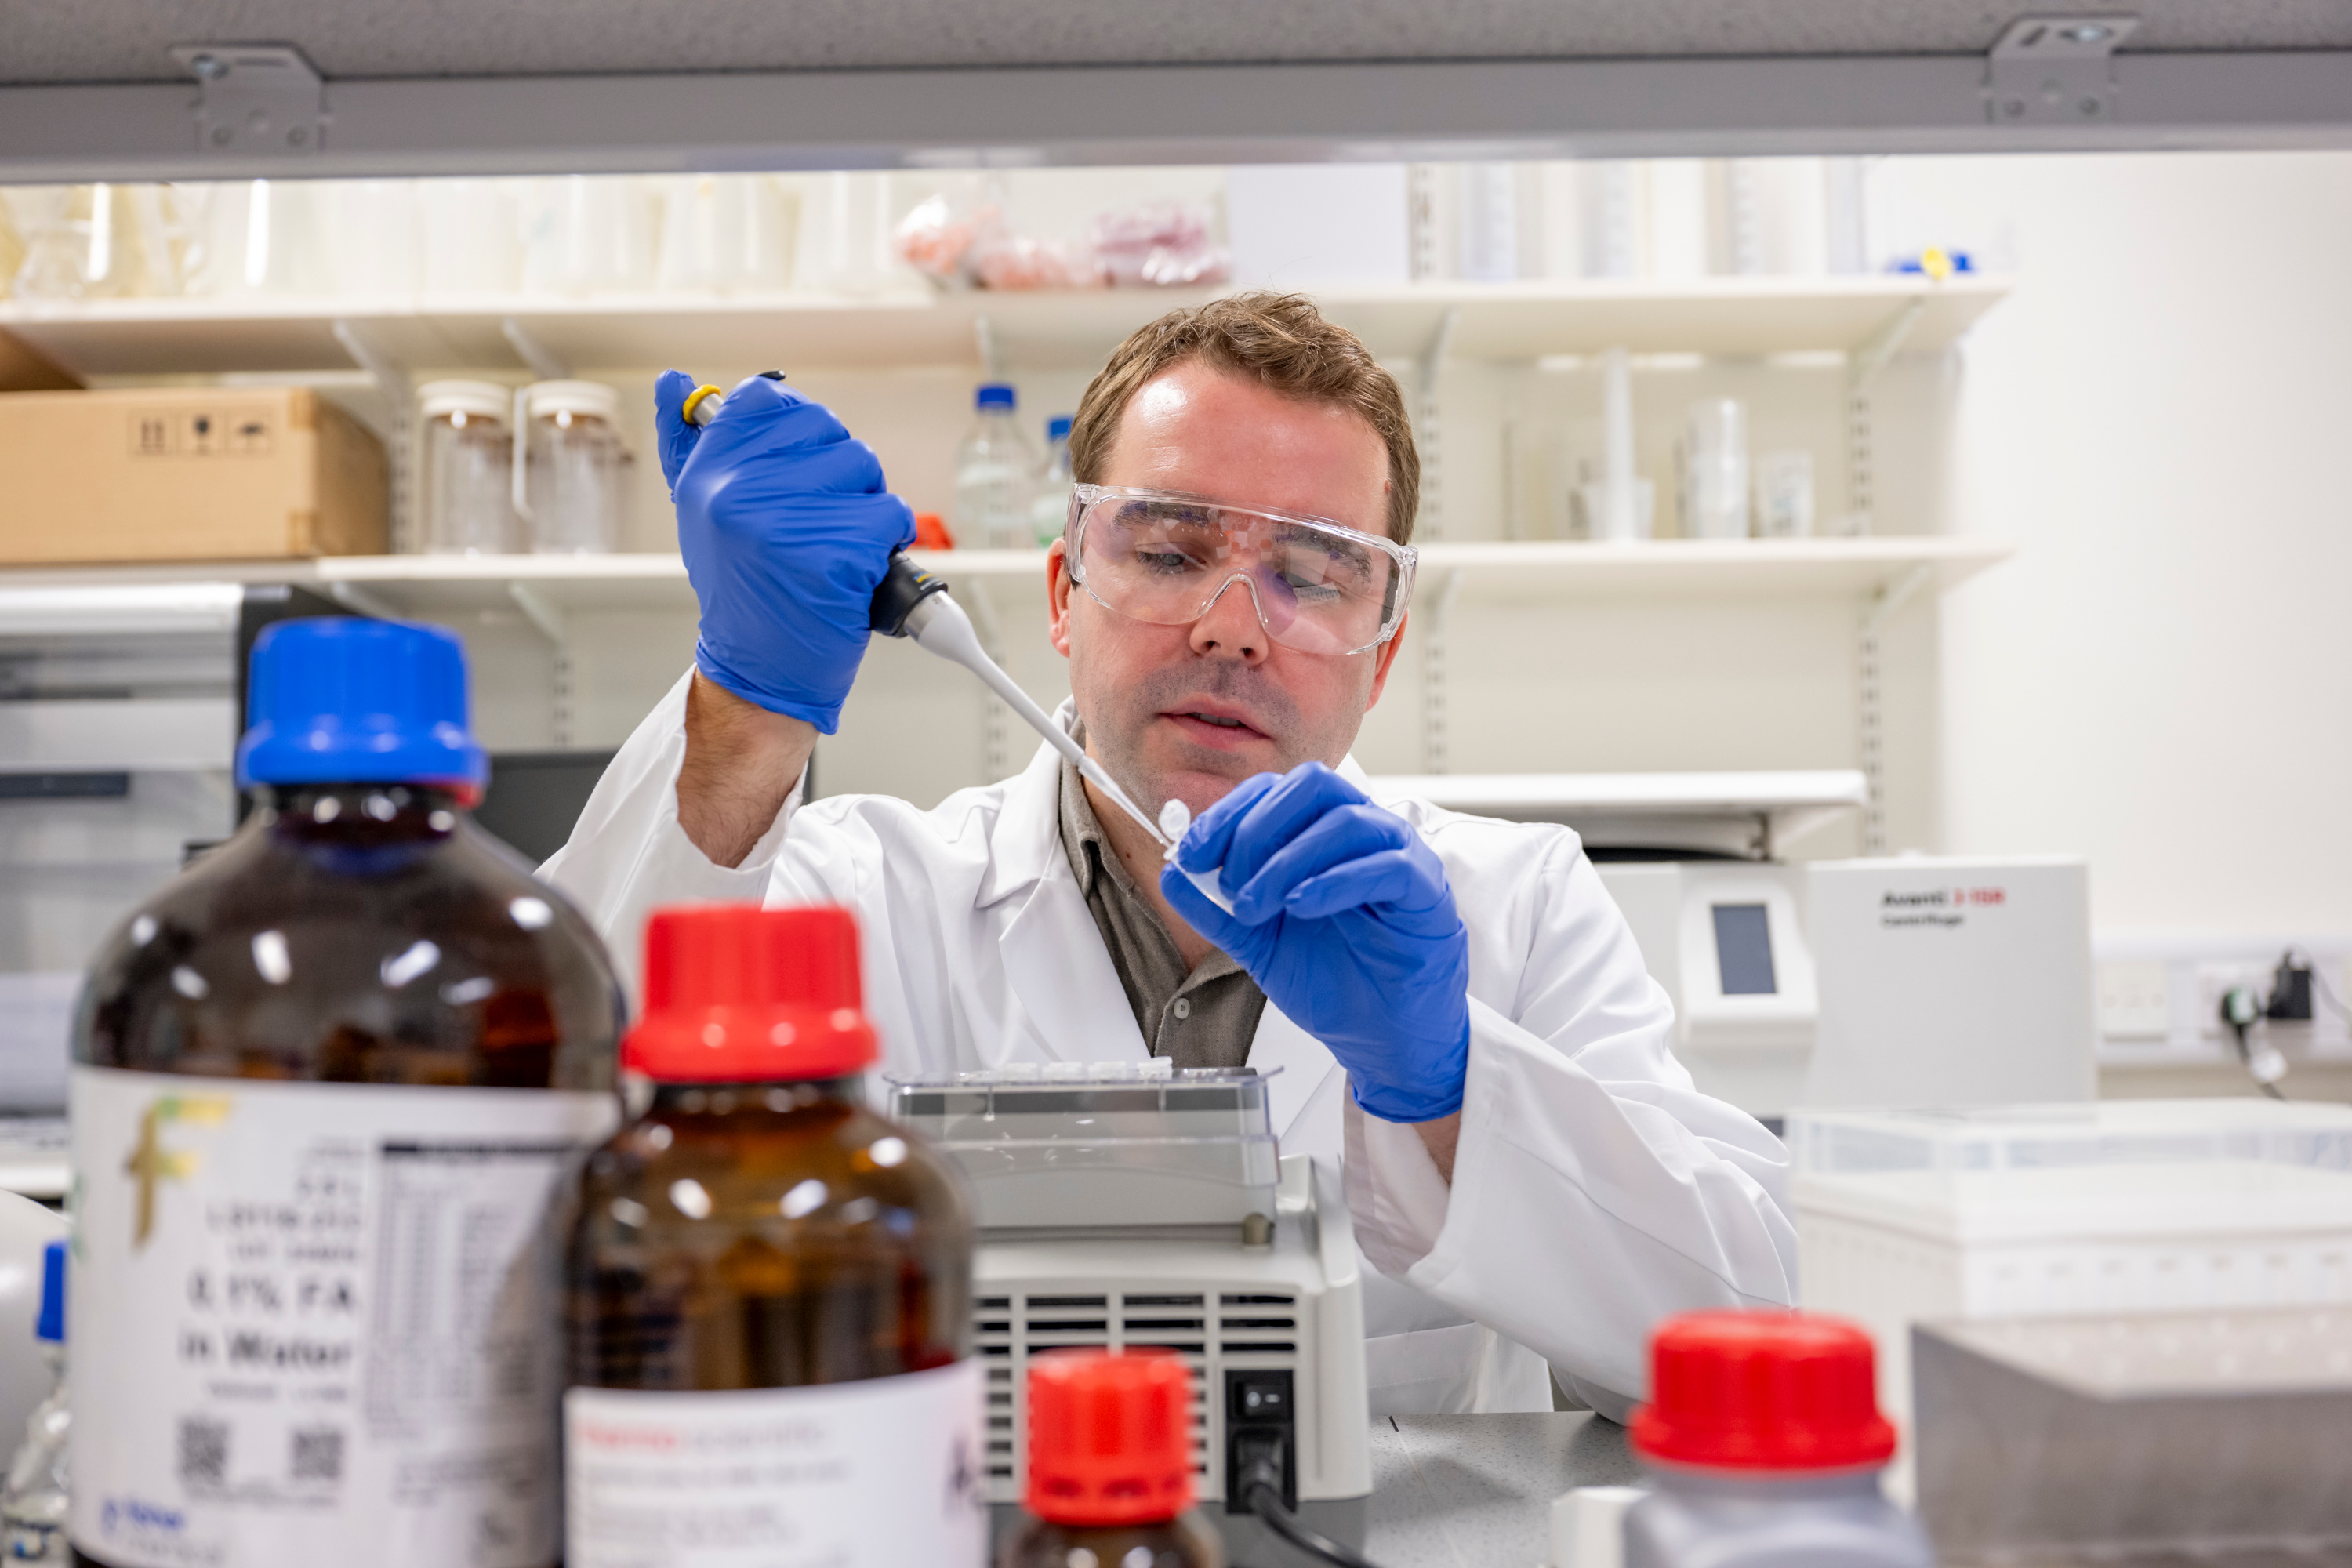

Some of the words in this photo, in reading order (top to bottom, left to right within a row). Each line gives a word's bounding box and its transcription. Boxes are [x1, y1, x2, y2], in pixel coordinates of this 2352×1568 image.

[1882, 890, 1946, 906] Avanti
[299, 1276, 357, 1312] FA
[180, 1329, 214, 1364] in
[230, 1329, 352, 1369] Water
